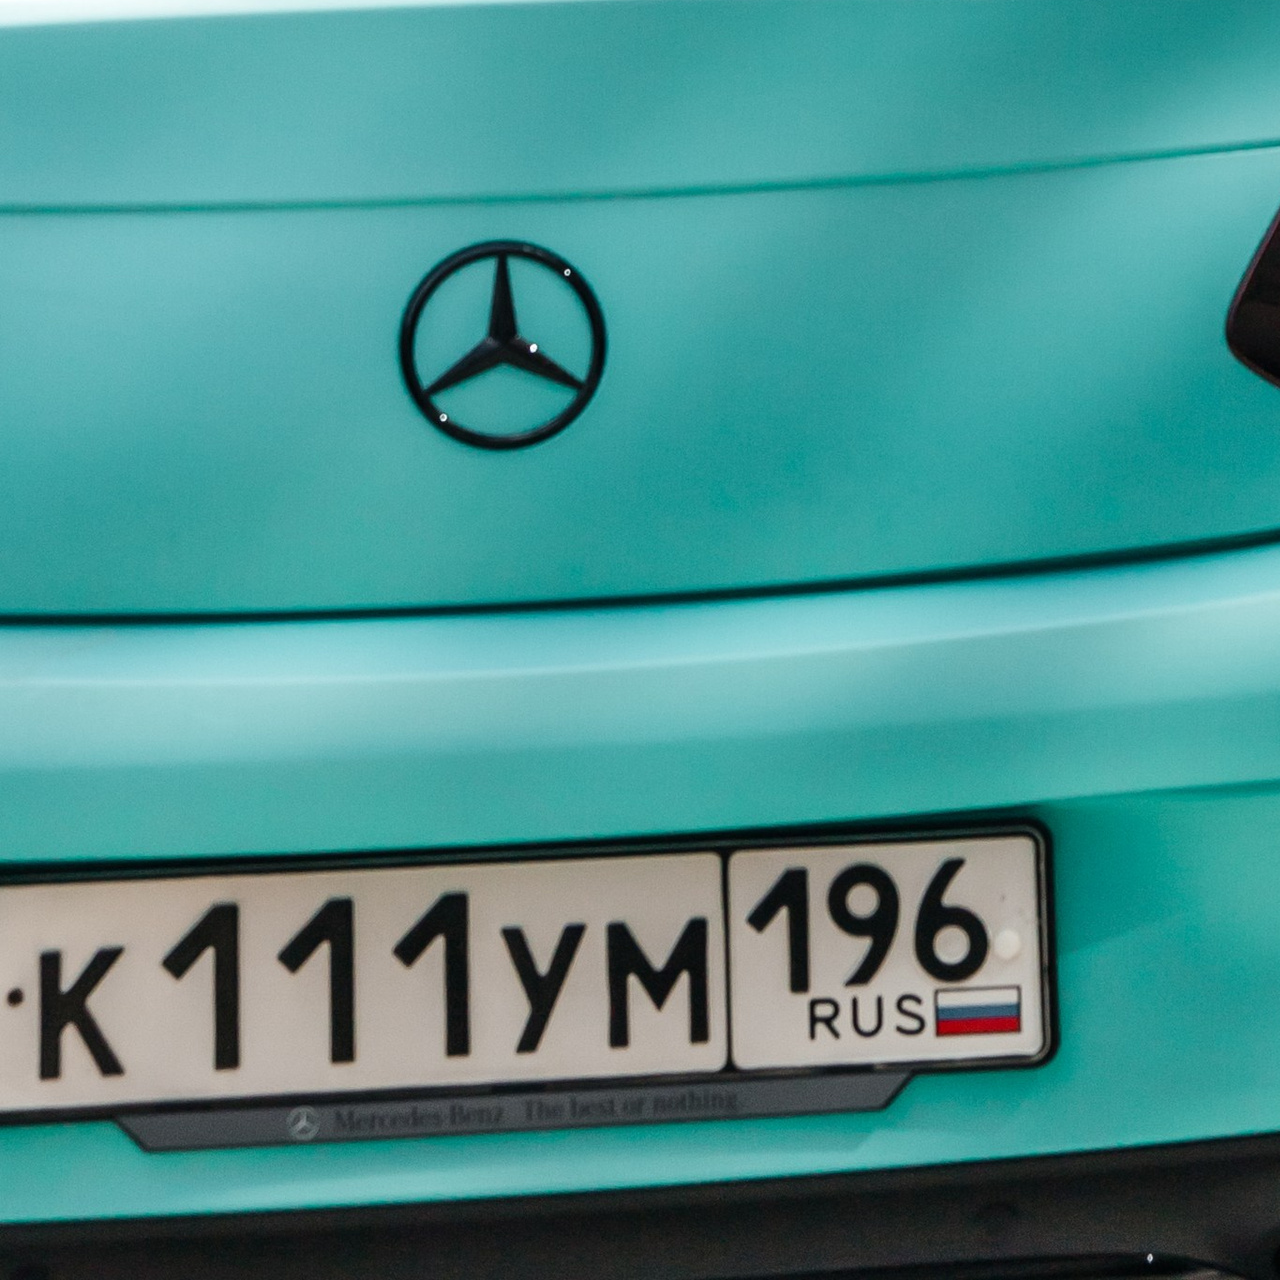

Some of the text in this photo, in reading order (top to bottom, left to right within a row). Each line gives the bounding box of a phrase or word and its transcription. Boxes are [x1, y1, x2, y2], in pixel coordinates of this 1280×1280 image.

[746, 856, 990, 994] 196
[808, 993, 926, 1040] RUS
[525, 1098, 566, 1121] The
[569, 1095, 616, 1118] best
[622, 1097, 647, 1115] or
